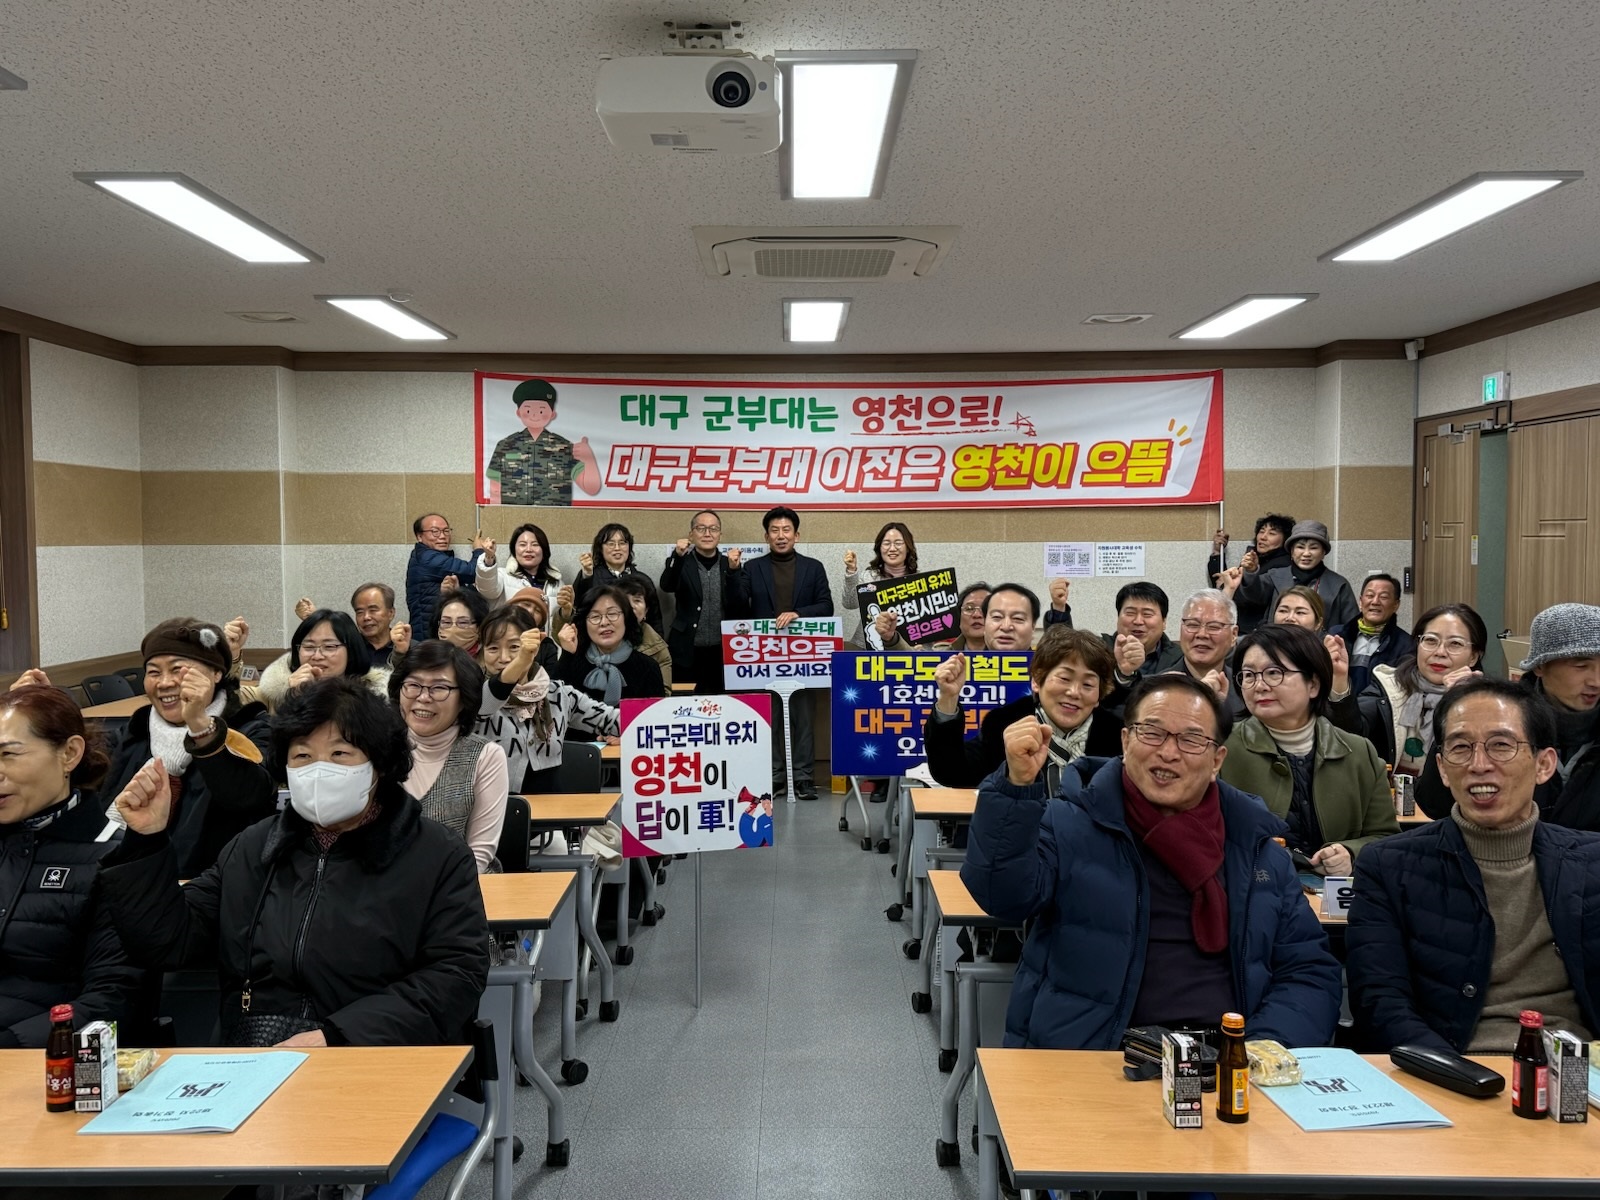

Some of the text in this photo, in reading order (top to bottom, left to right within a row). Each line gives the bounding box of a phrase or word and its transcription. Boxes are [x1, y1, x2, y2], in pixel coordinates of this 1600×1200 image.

[620, 394, 1003, 433] 대구 군부대는 영천으로!
[605, 438, 1173, 493] 대구군부대 이전은 영천이 으뜸
[876, 571, 953, 605] 대구군부대 유치!
[887, 590, 959, 626] 영천시민의
[787, 621, 836, 636] 군부대
[906, 617, 944, 641] 힘으로
[729, 635, 835, 663] 영천으로
[736, 663, 832, 678] 어서 오세요!
[855, 655, 1031, 682] 대구도철도
[636, 720, 757, 749] 대구군부대 유치
[854, 708, 912, 734] 대구
[631, 752, 727, 796] 영천이
[636, 799, 735, 841] 답이 軍!
[50, 1077, 72, 1091] 홍삼
